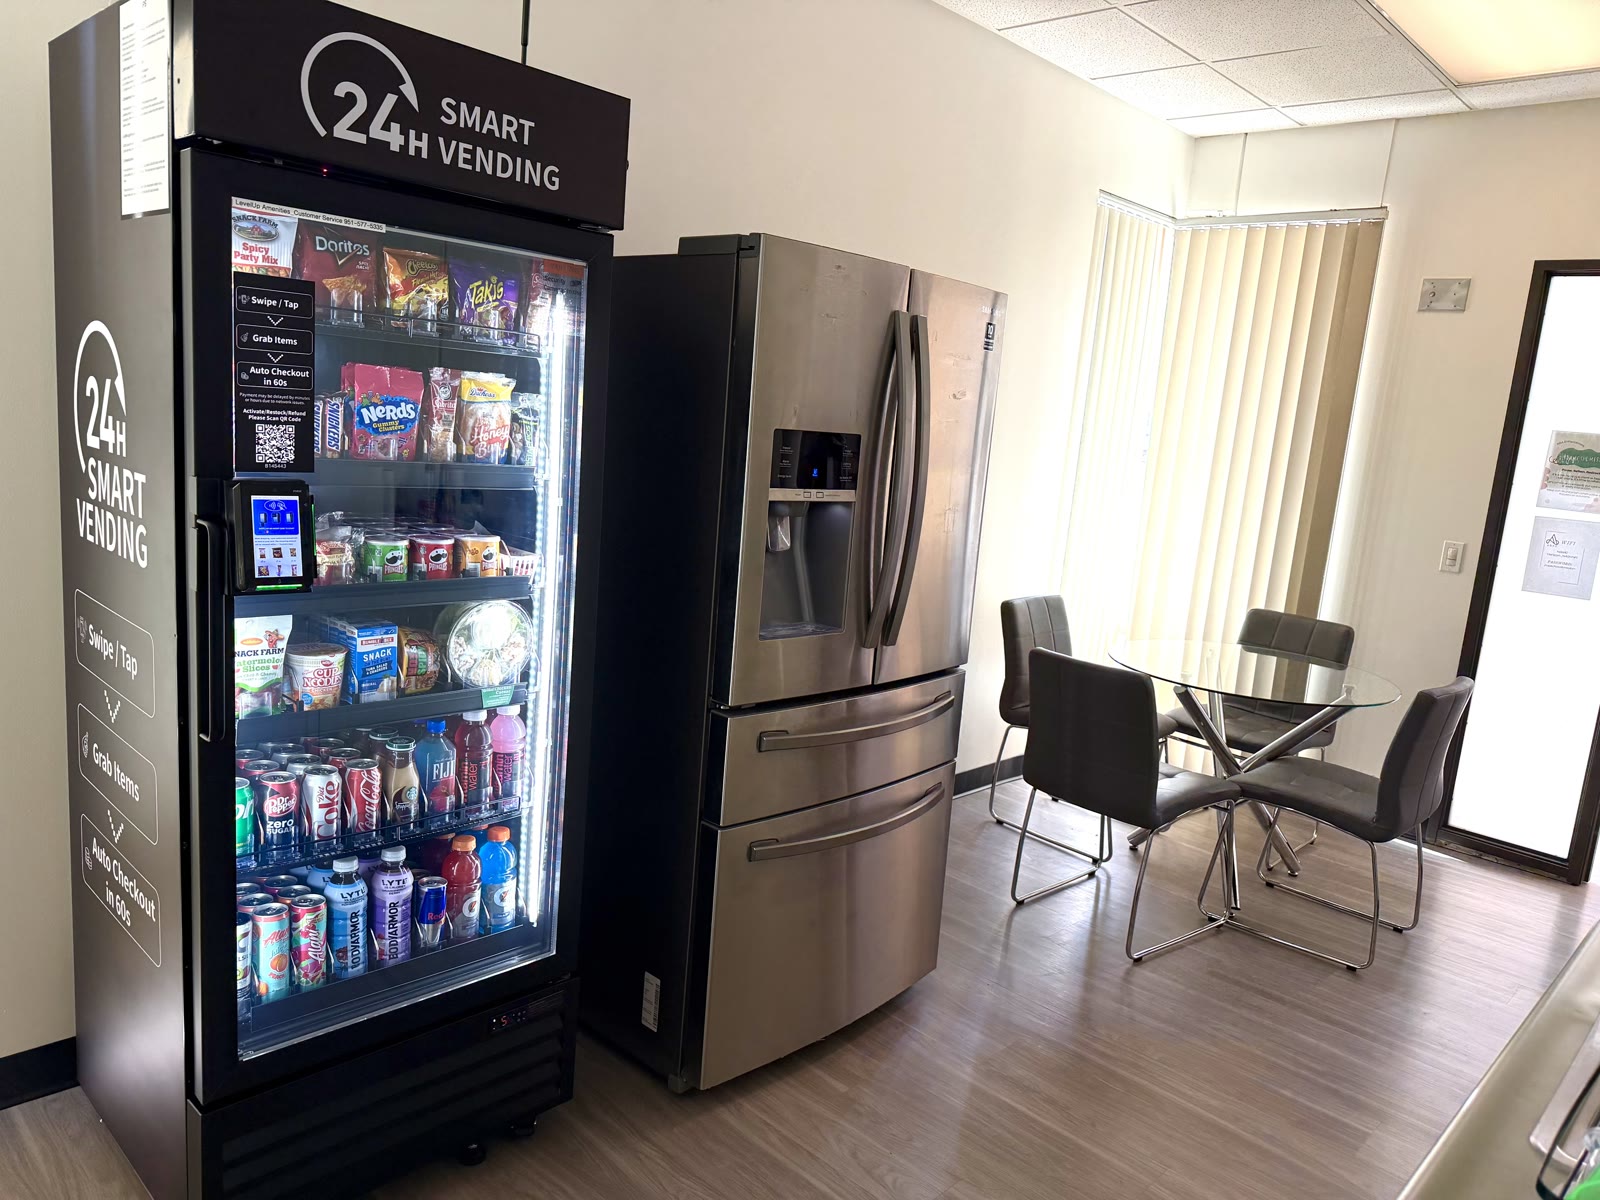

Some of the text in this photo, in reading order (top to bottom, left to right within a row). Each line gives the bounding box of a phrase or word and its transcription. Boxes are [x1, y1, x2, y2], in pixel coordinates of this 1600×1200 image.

[332, 80, 429, 159] 24H
[439, 97, 536, 146] SMART
[437, 136, 561, 192] VENDING
[236, 200, 260, 210] LevelUp
[322, 215, 342, 224] Service
[344, 219, 384, 231] 951-577-5335
[258, 216, 278, 228] FARM
[242, 242, 270, 254] Spicy
[315, 236, 370, 256] Doritos
[234, 251, 278, 265] Party Mix
[469, 276, 504, 306] Takis
[544, 274, 566, 286] Security
[252, 296, 298, 310] Swipe / Tap
[252, 334, 298, 346] Grab Items
[250, 366, 310, 378] Auto Checkout
[264, 378, 272, 386] in
[85, 375, 127, 458] 24H
[360, 402, 416, 424] Nerds
[372, 420, 399, 428] Gummy
[328, 399, 340, 450] SNICKERS
[378, 424, 404, 432] Clusters
[470, 426, 509, 443] Honey
[88, 456, 146, 519] SMART
[76, 497, 148, 569] VENDING
[88, 623, 138, 680] Swipe / Tap
[363, 648, 392, 662] SNACK
[303, 676, 342, 687] NOODLES
[314, 668, 339, 678] CUP
[92, 743, 140, 802] Grab Items
[432, 760, 456, 780] FIJI
[469, 762, 478, 790] water
[504, 754, 512, 782] water
[268, 797, 296, 814] Pepper
[279, 796, 290, 804] Dr
[317, 780, 338, 840] Coke
[358, 768, 380, 831] Coca-Cola
[267, 819, 294, 828] zero
[92, 836, 156, 922] Auto Checkout
[106, 880, 131, 927] in 60s
[351, 910, 360, 970] BODYARMOR
[388, 901, 400, 960] BODYARMOR
